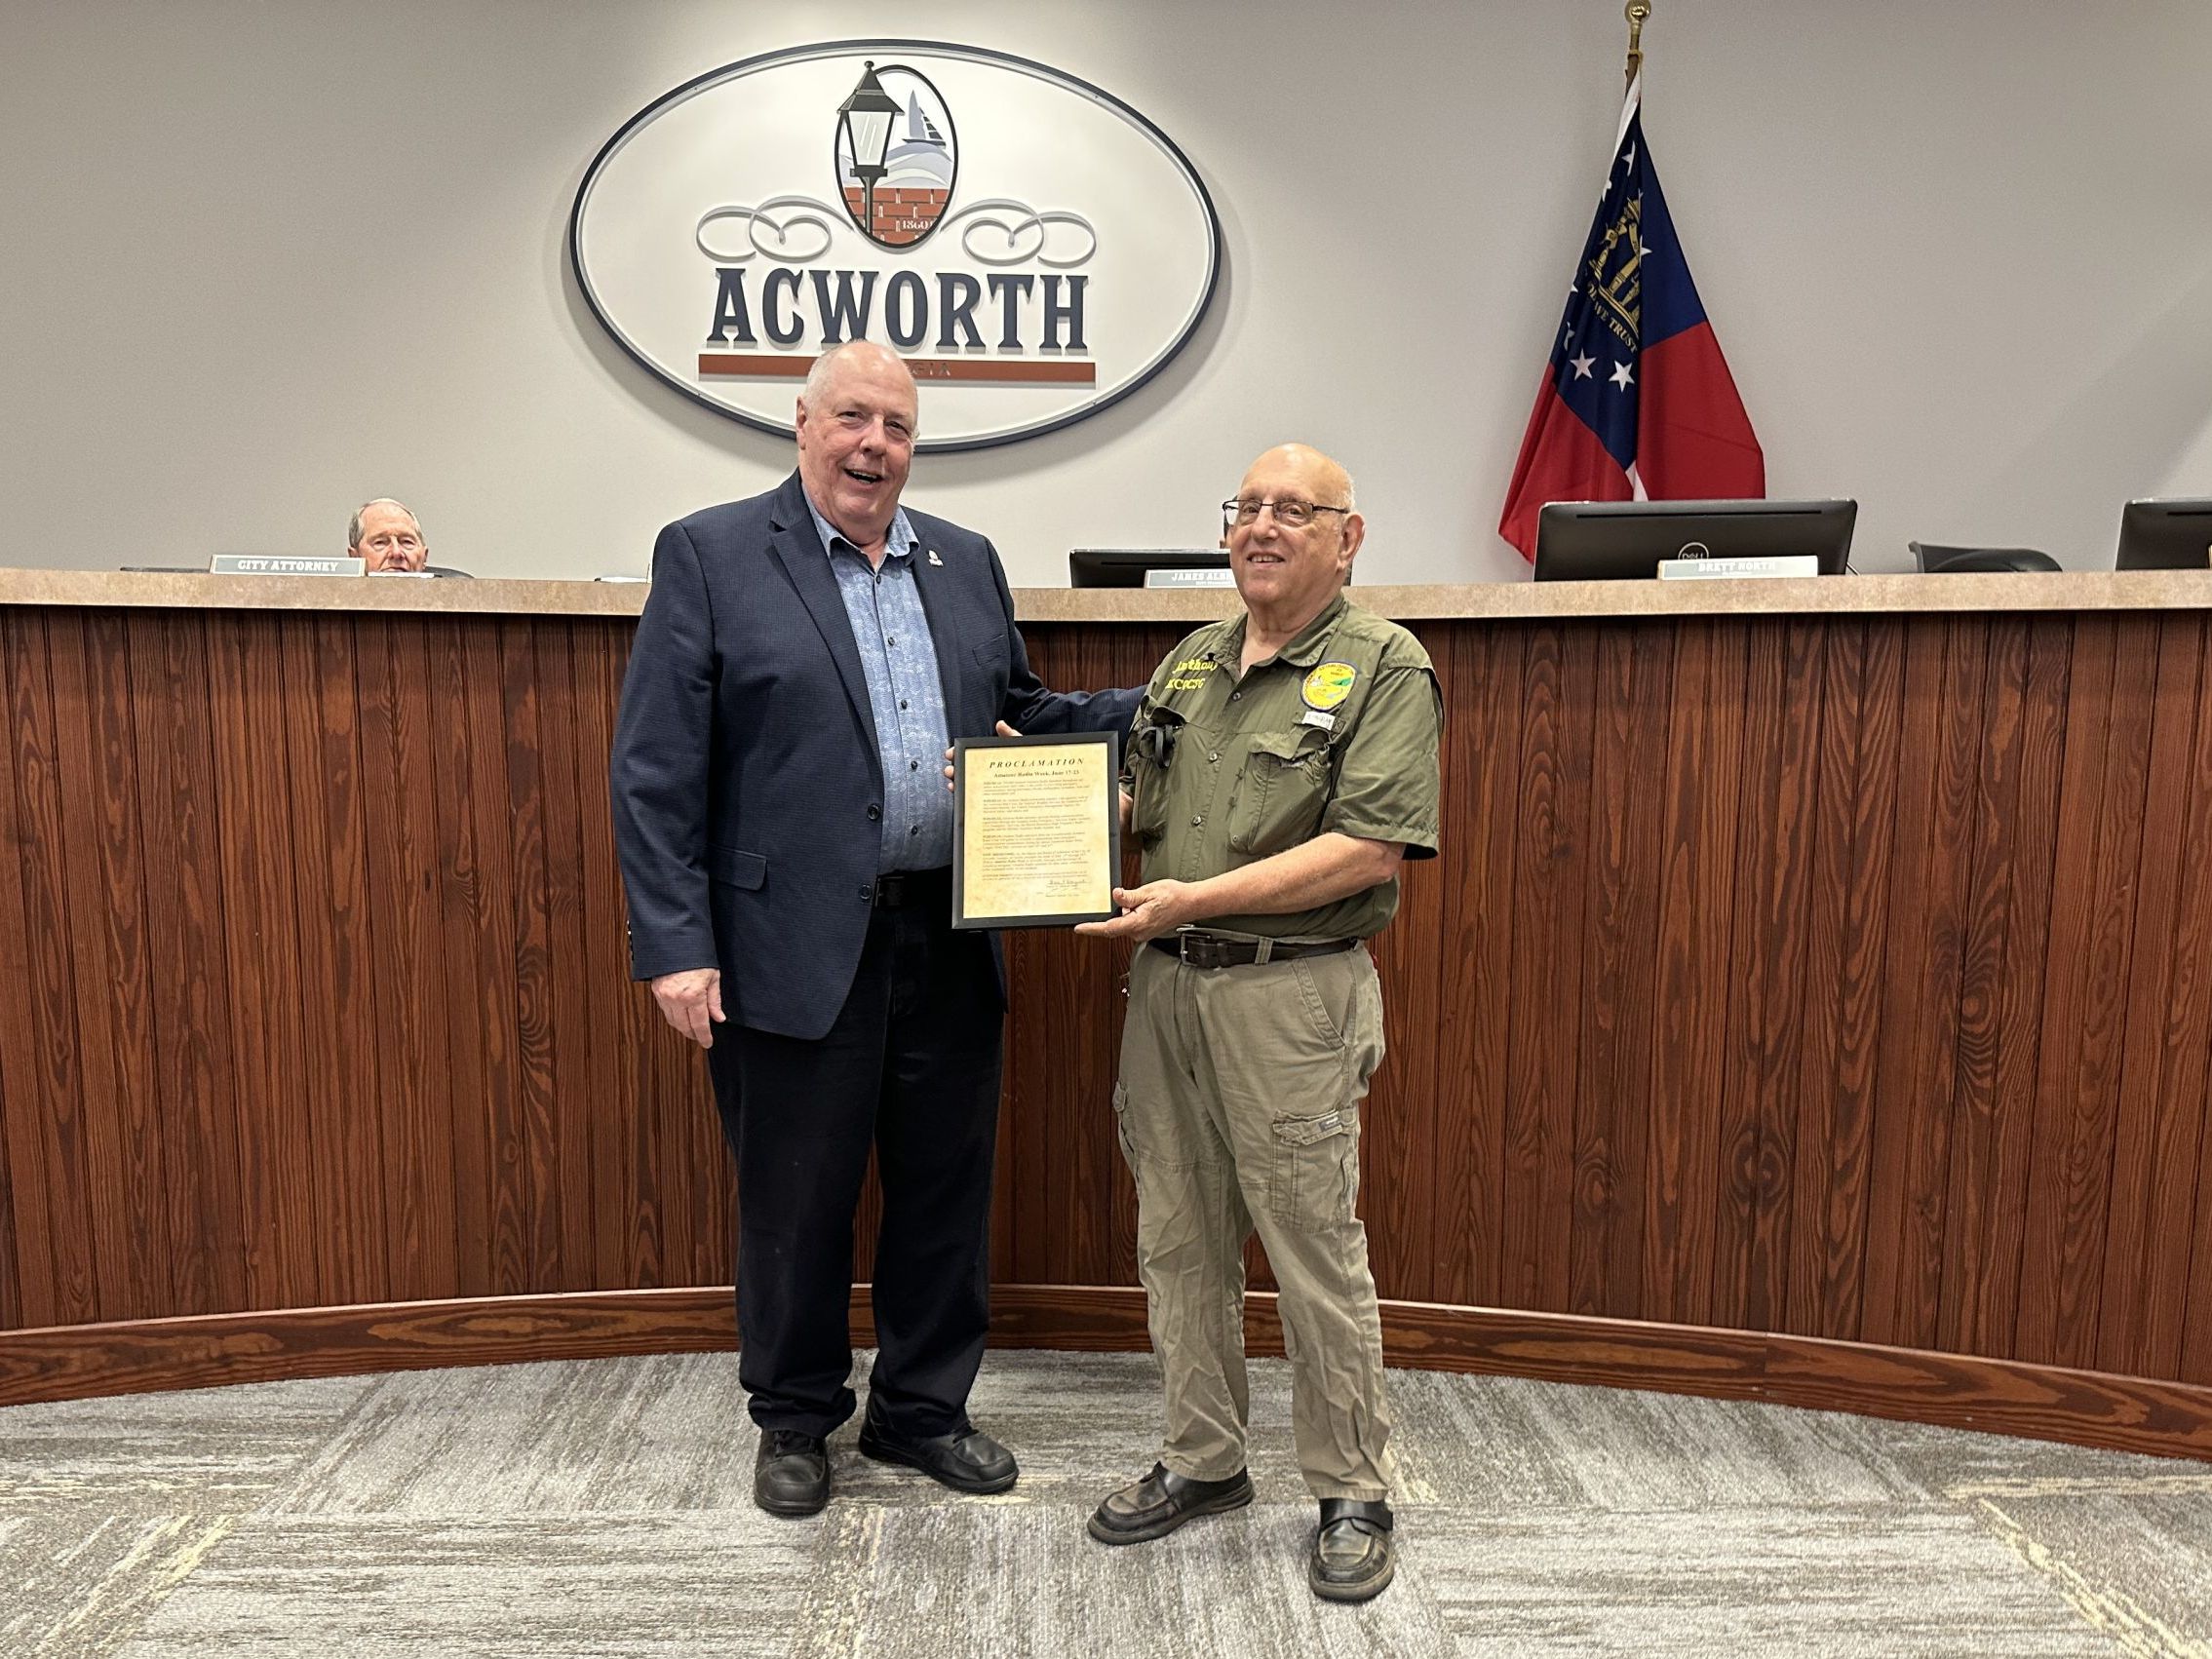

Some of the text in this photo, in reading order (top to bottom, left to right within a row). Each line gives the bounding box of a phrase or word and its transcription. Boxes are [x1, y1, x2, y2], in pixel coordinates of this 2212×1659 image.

[707, 268, 1089, 349] ACWORTH
[1609, 318, 1638, 354] TRUST
[238, 559, 339, 572] CITY ATTORNEY
[1698, 561, 1775, 572] BRETT NORTH
[1172, 572, 1204, 582] JAMES
[989, 757, 1084, 769] PROCLAMATION
